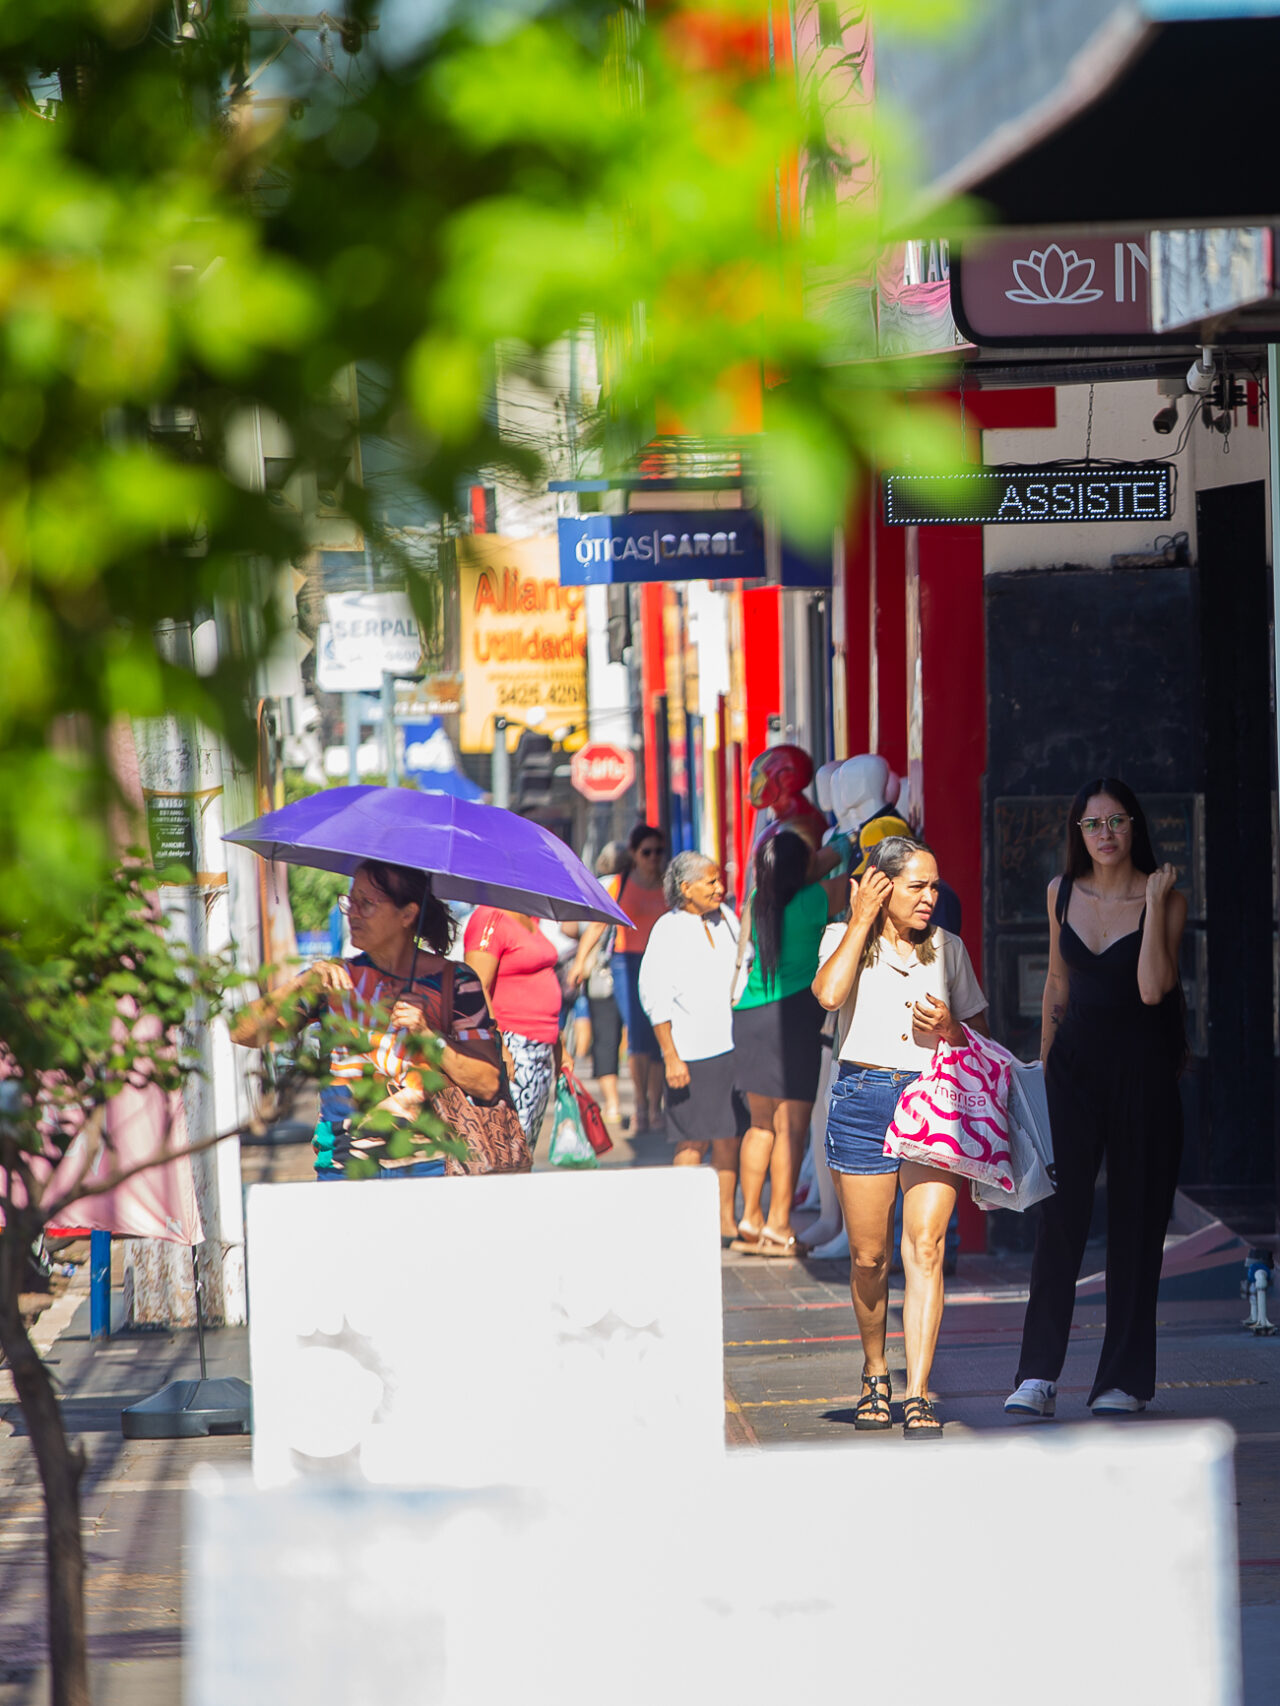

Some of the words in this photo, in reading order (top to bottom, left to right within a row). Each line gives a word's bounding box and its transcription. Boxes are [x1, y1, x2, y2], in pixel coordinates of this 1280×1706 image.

[998, 482, 1166, 515] ASSISTE
[575, 533, 654, 563] ÓTICAS
[660, 531, 744, 558] CAROL
[474, 566, 586, 621] Alianç
[335, 619, 419, 638] SERPAL
[474, 629, 587, 662] Utilidade
[934, 1084, 987, 1108] marisa
